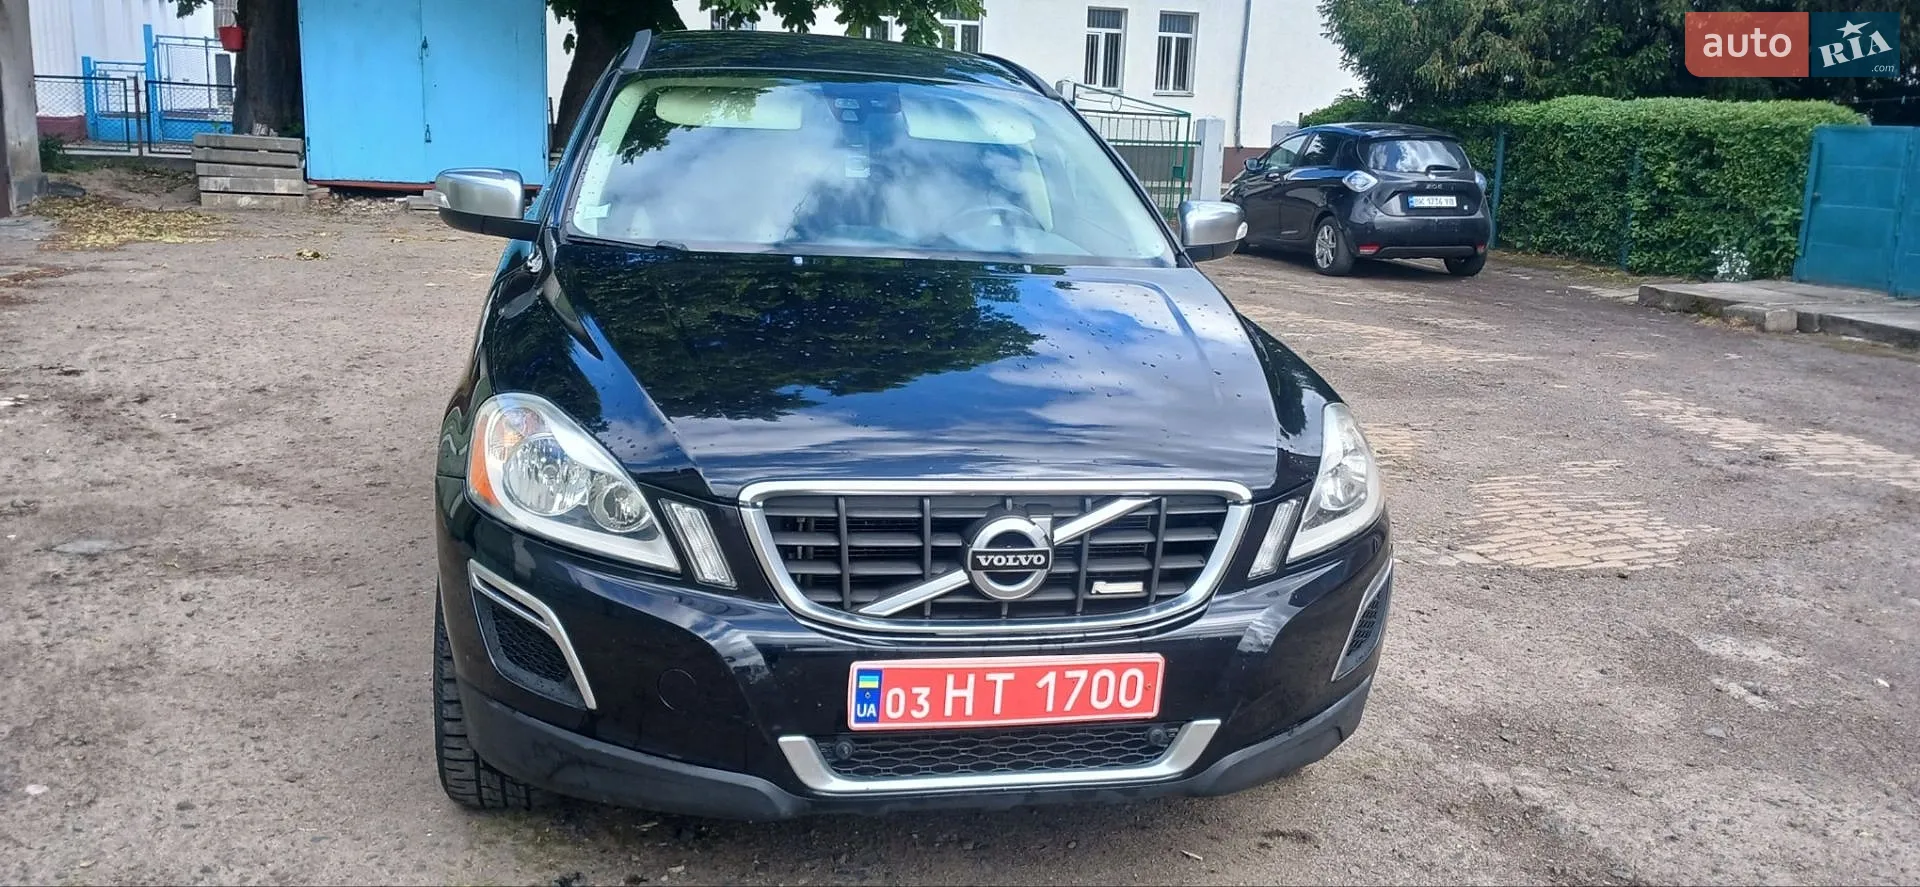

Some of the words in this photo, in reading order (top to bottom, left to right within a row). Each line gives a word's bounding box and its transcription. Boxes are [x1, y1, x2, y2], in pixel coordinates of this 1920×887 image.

[976, 554, 1046, 567] VOLVO
[885, 687, 931, 719] 03
[943, 671, 1016, 717] HT
[1035, 667, 1145, 713] 1700
[856, 702, 877, 718] UA
